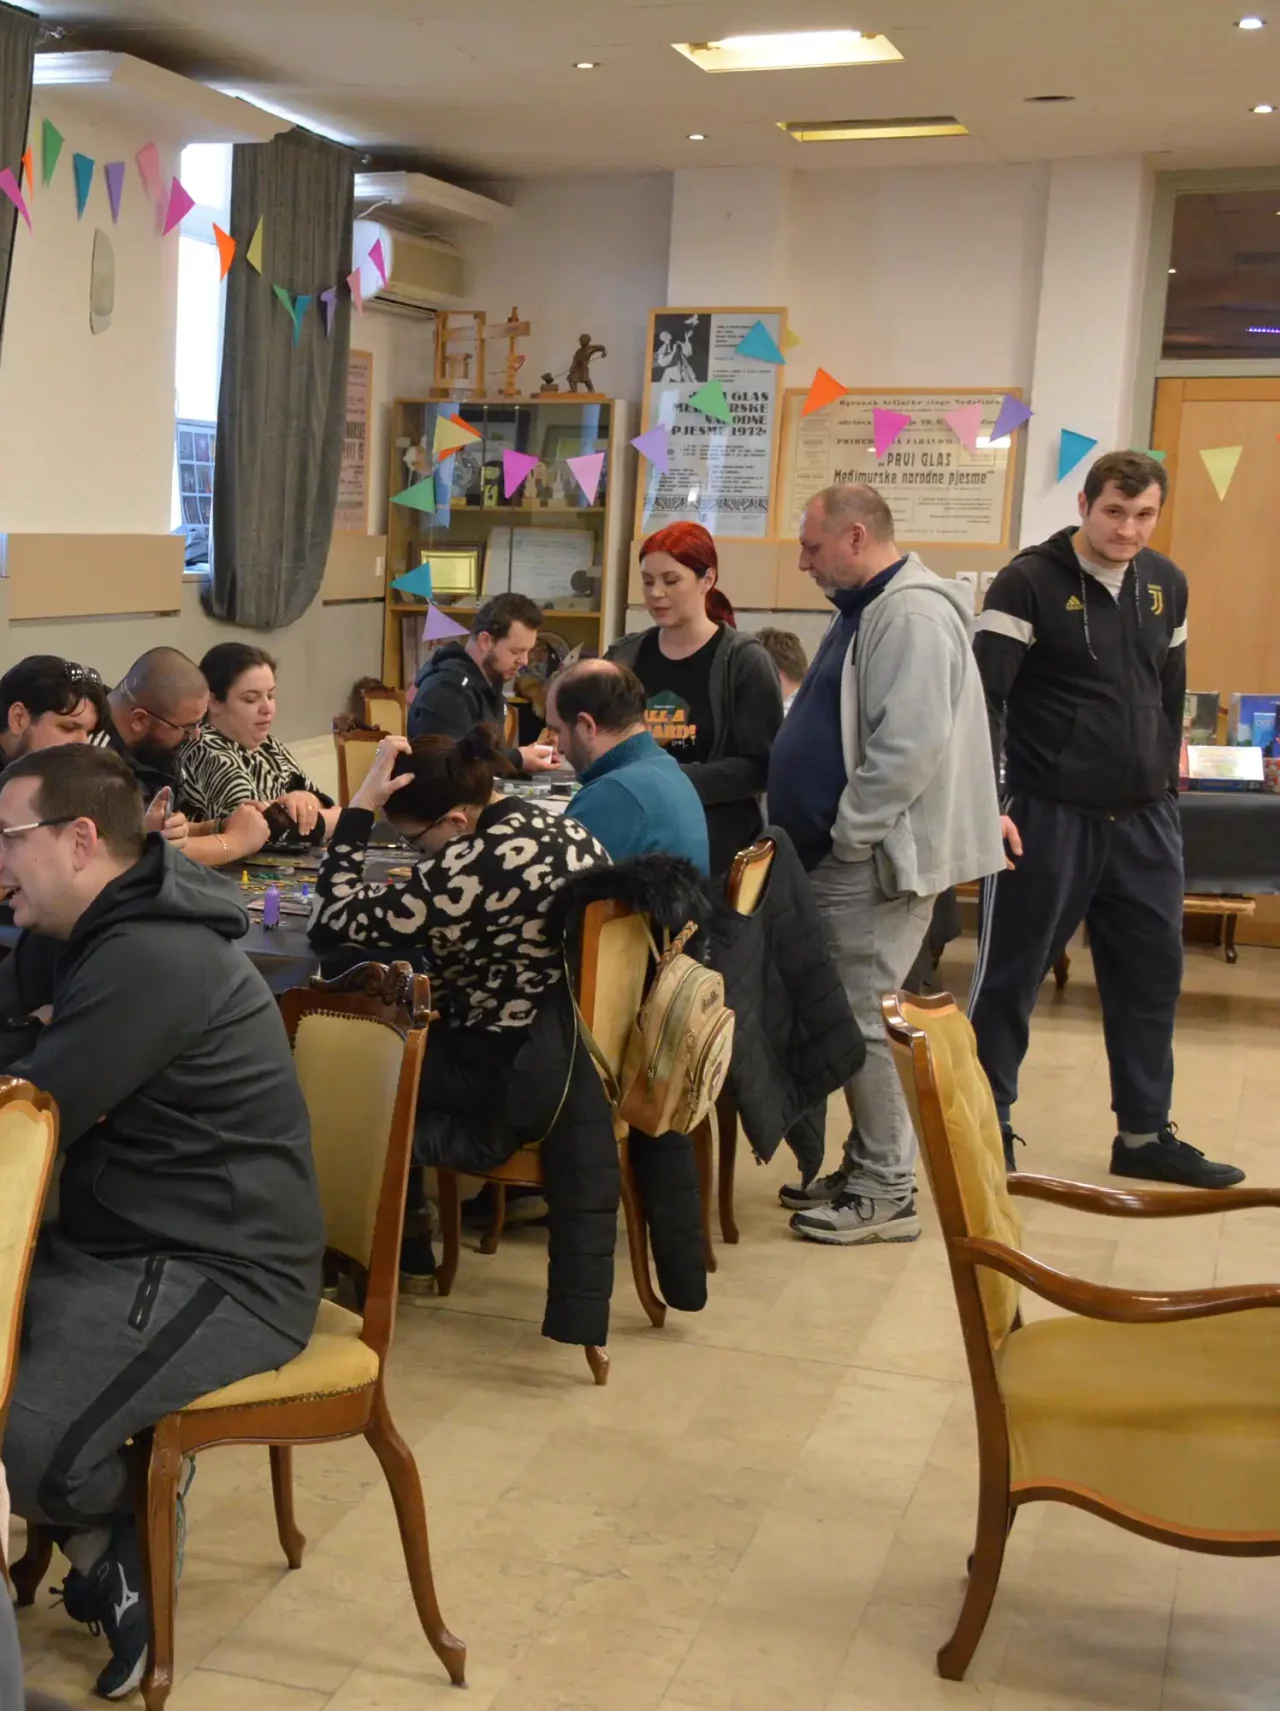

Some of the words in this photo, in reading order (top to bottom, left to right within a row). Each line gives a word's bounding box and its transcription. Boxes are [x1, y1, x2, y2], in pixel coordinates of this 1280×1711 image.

[731, 391, 769, 401] GLAS
[674, 403, 768, 413] MERSKE
[921, 452, 951, 467] GLAS
[902, 471, 944, 484] narodne
